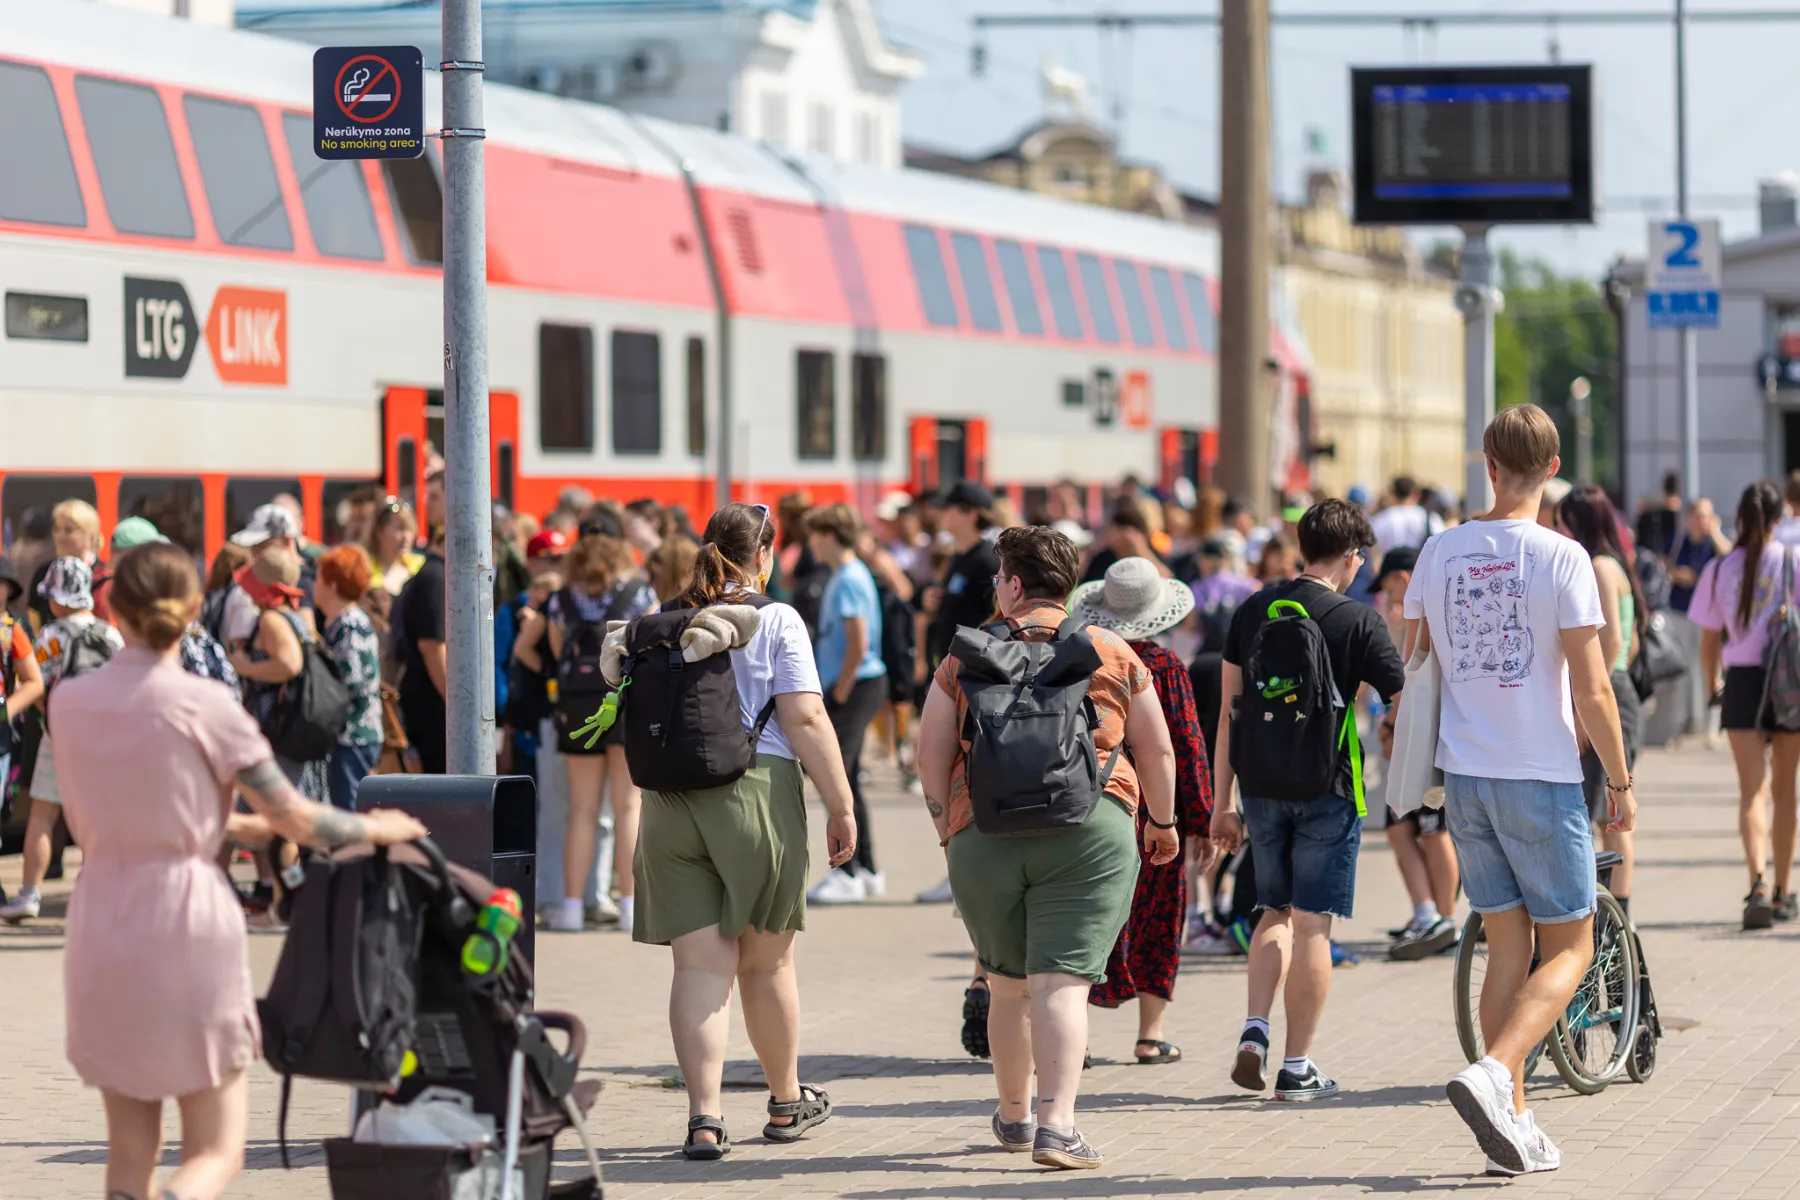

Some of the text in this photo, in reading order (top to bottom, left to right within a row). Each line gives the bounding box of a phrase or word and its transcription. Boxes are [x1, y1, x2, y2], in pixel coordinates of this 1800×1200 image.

[321, 138, 415, 150] No smoking area
[325, 126, 410, 138] Nerūkymo zona
[1665, 223, 1699, 267] 2
[136, 297, 186, 361] LTG
[219, 305, 281, 368] LINK
